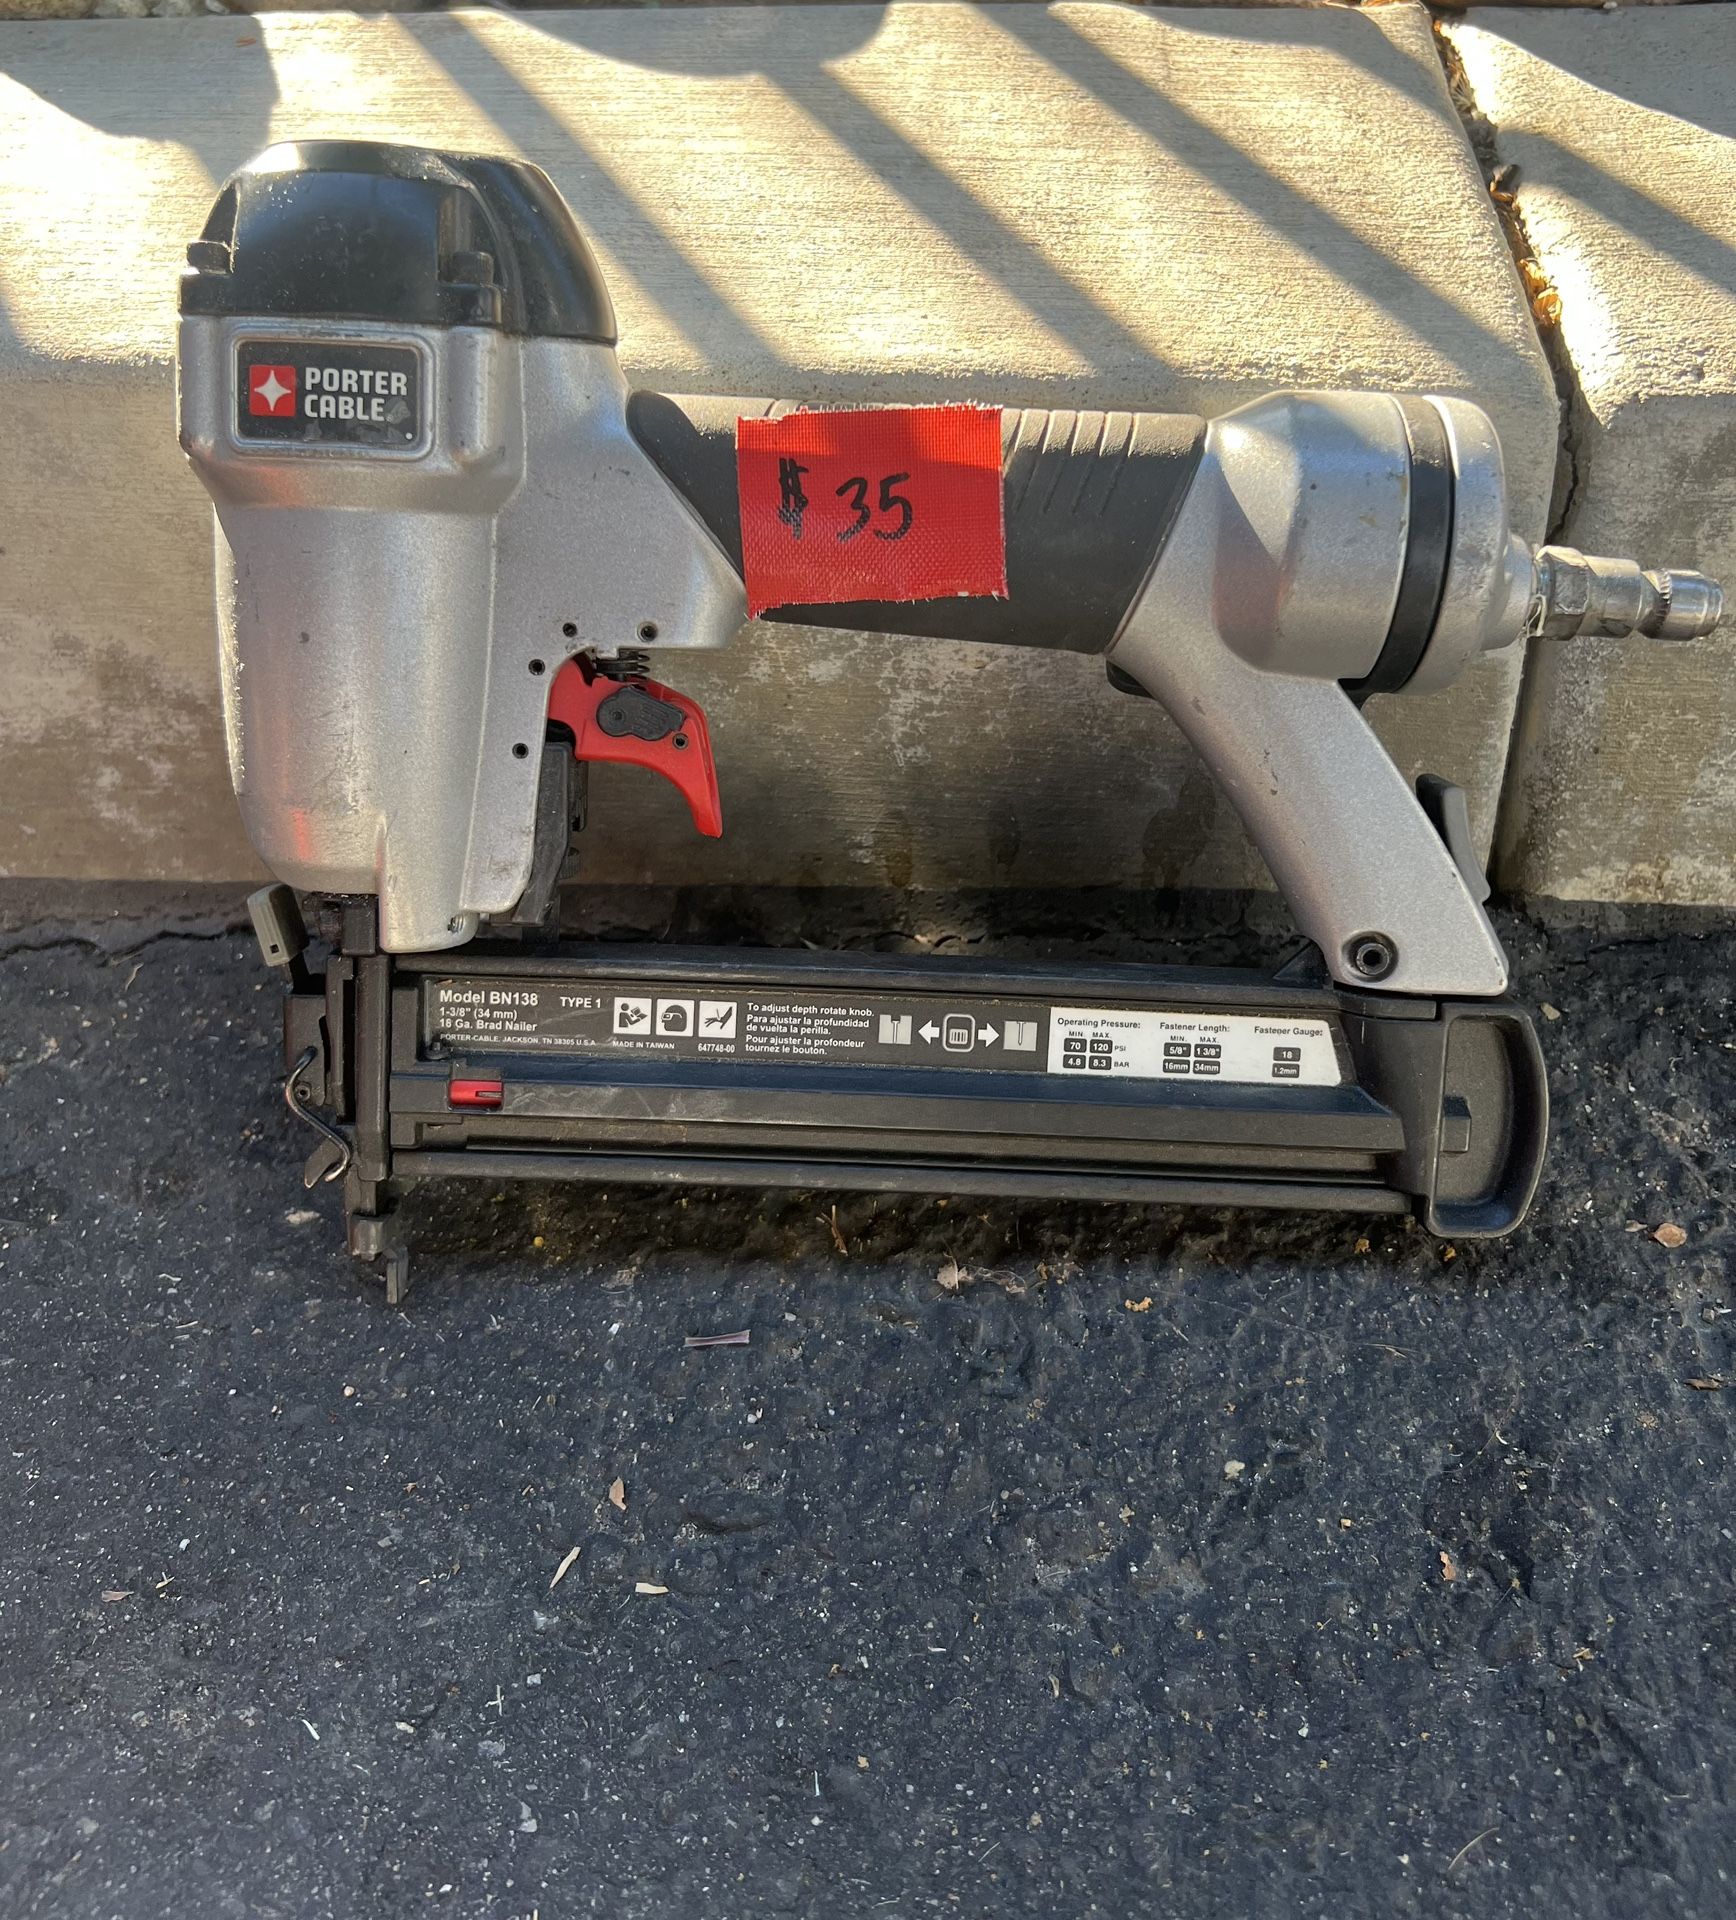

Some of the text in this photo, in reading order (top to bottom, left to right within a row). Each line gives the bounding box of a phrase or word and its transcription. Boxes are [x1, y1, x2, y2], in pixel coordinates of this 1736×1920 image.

[305, 367, 407, 396] PORTER
[304, 394, 385, 421] CABLE
[836, 472, 913, 542] 35
[440, 990, 538, 1005] Model BN138
[560, 996, 601, 1008] TYPE 1
[474, 1008, 491, 1019] (34
[493, 1010, 517, 1021] mm)
[747, 1002, 874, 1016] To adjust depth rotate knob.
[439, 1019, 537, 1031] 18 Ga. Brad Nailer
[747, 1014, 767, 1022] Para
[770, 1015, 801, 1025] ajustar
[814, 1018, 869, 1028] profundidad
[1058, 1018, 1140, 1029] Operating Pressure:
[746, 1023, 831, 1035] de vuelta la perilla.
[1160, 1022, 1230, 1033] Fastener Length:
[1254, 1026, 1322, 1036] Fastener Gauge:
[746, 1034, 864, 1048] Pour ajuster la profondeur
[1070, 1042, 1080, 1050] 70
[1093, 1043, 1108, 1051] 120
[698, 1043, 735, 1053] 647748-00
[746, 1044, 827, 1055] tournez le bouton.
[1165, 1062, 1218, 1072] 16mm 34mm
